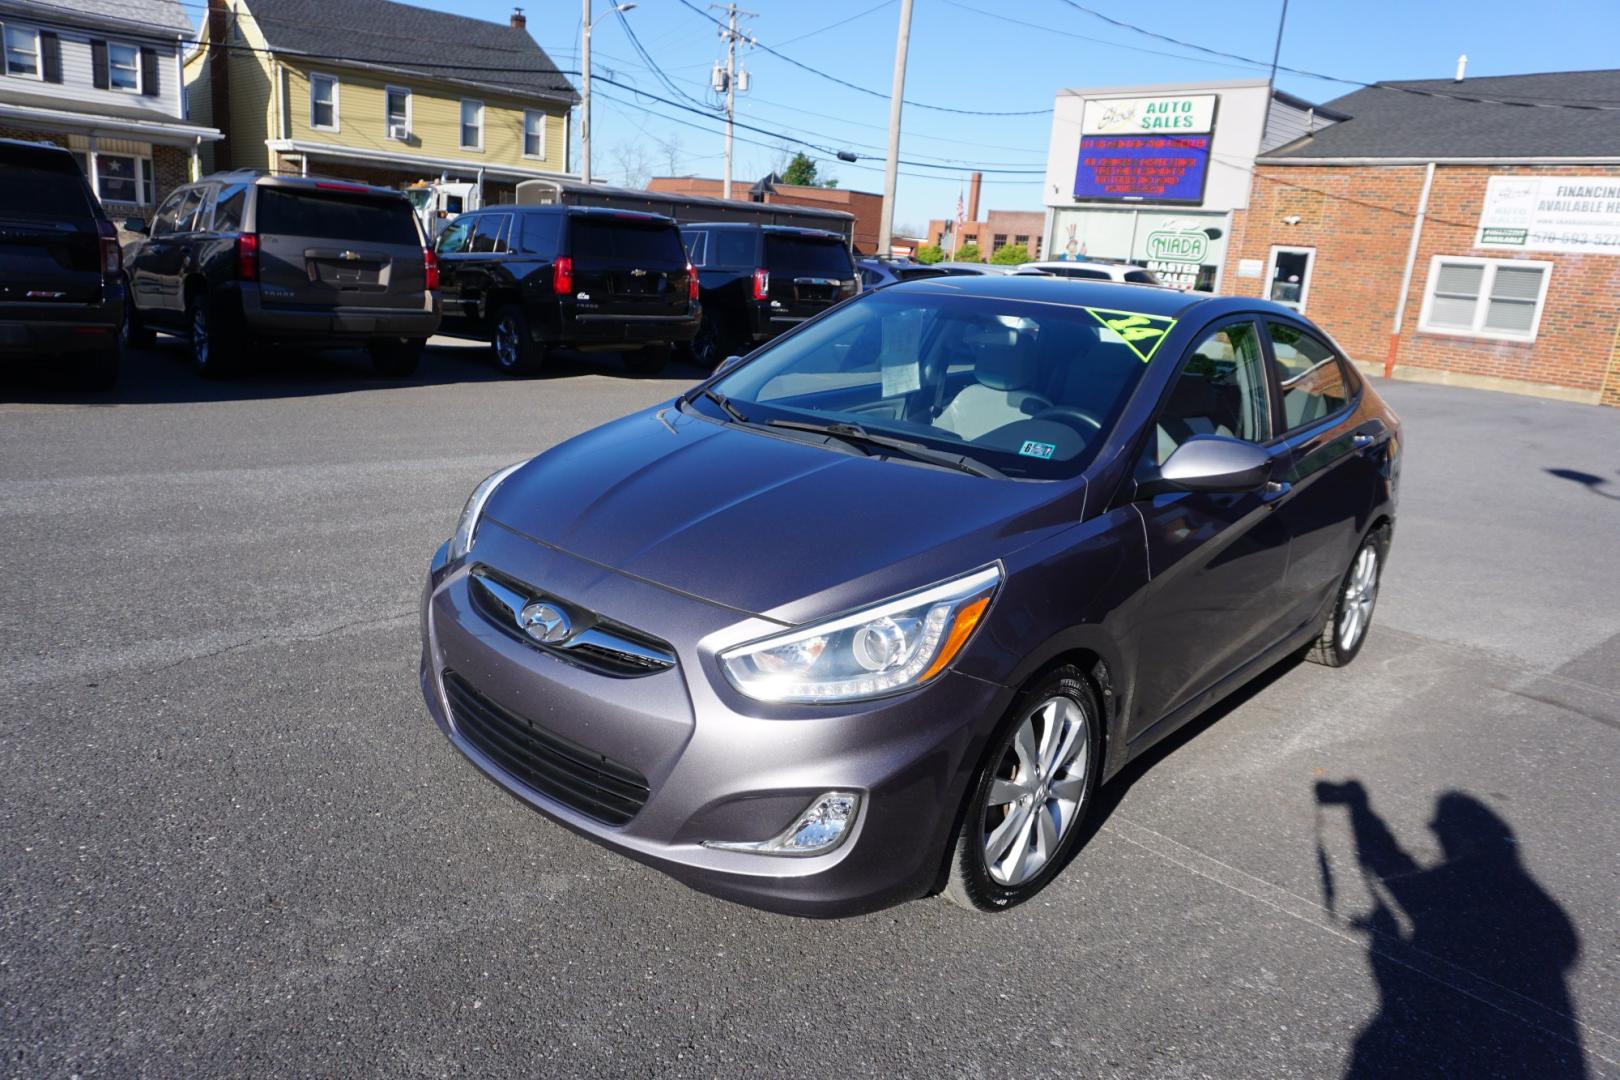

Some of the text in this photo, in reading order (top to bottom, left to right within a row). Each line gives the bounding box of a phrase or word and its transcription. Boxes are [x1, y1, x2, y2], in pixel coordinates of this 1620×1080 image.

[1145, 101, 1193, 114] AUTO
[1141, 115, 1193, 129] SALES
[1537, 200, 1601, 212] AVAILABLE
[1152, 238, 1201, 255] NIADA
[1147, 261, 1200, 274] MASTER
